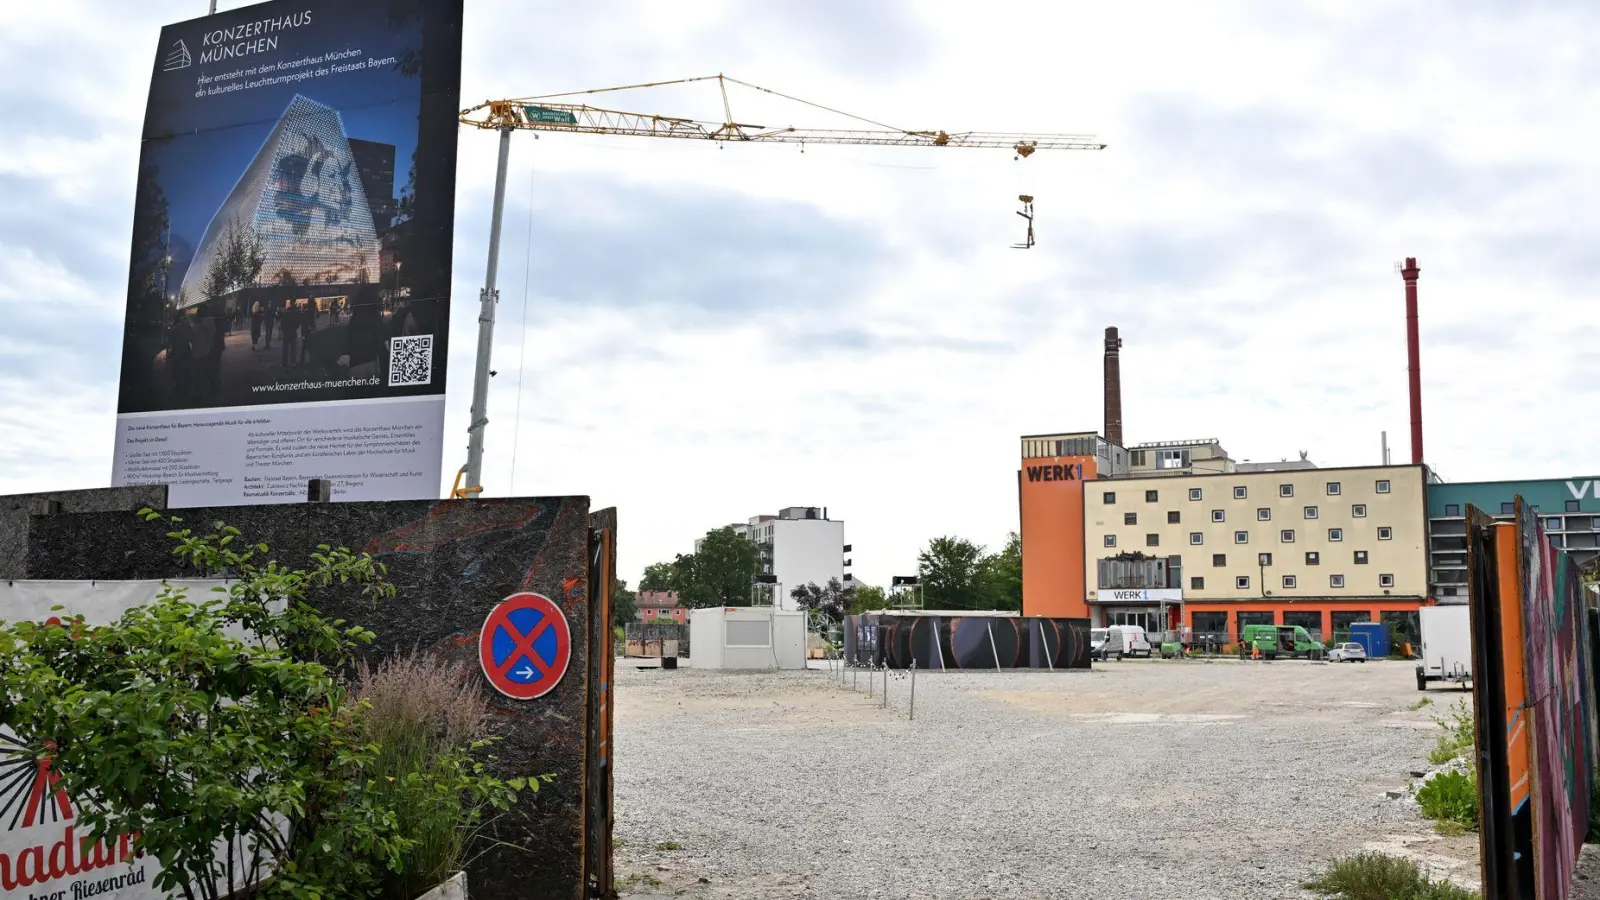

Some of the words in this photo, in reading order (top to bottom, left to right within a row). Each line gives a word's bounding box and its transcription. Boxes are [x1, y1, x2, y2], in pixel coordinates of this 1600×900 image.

[203, 10, 312, 46] KONZERTHAUS
[197, 75, 213, 85] Hier
[214, 69, 243, 82] entsteht
[245, 66, 257, 76] mit
[258, 64, 275, 73] dem
[277, 56, 323, 70] Konzerthaus
[324, 48, 362, 62] München
[200, 36, 278, 64] MÜNCHEN
[195, 88, 207, 98] ein
[207, 82, 243, 96] kulturelles
[244, 69, 314, 89] Leuchtturmprojekt
[315, 67, 329, 77] des
[330, 60, 366, 74] Freistaats
[368, 56, 397, 68] Bayern.
[251, 375, 380, 392] www.konzerthaus-muenchen.de
[1027, 464, 1083, 482] WERK1
[70, 866, 145, 900] Riesenrad
